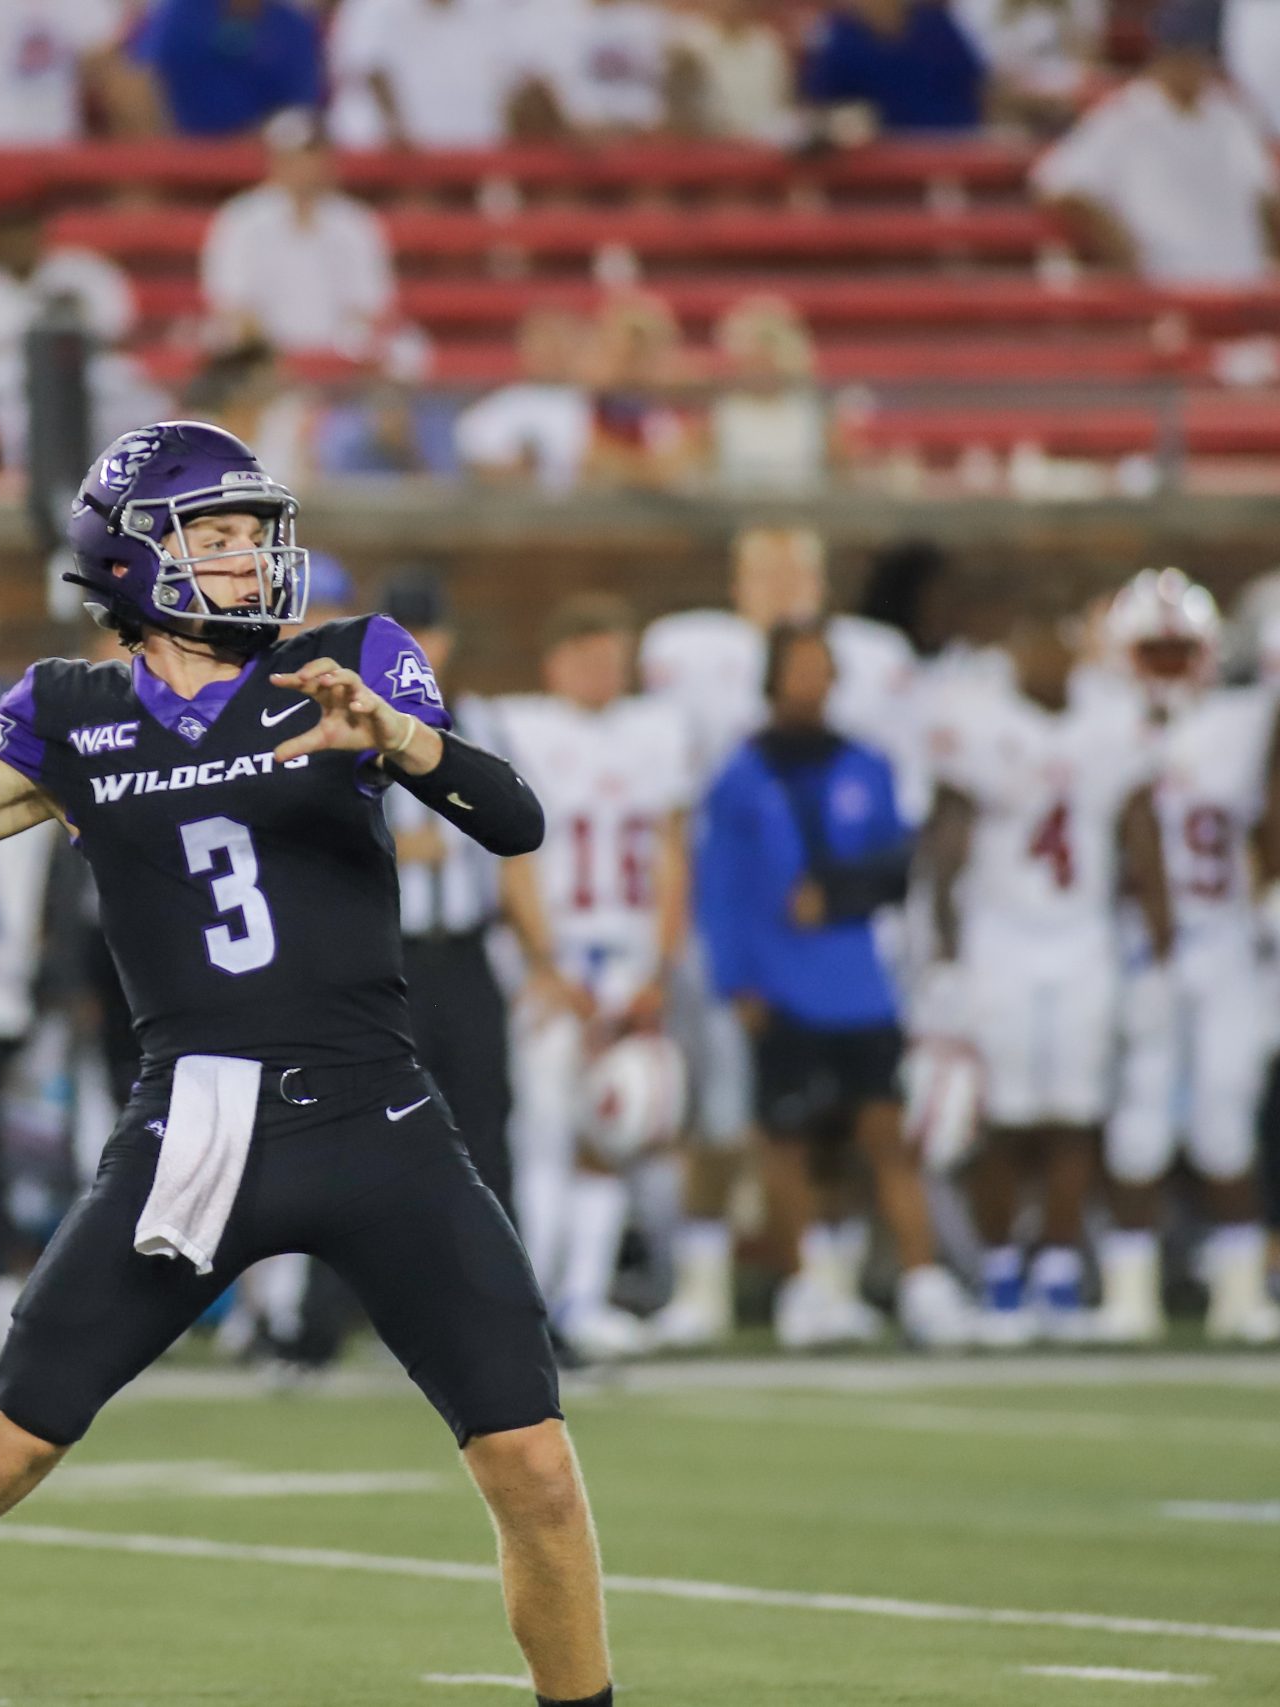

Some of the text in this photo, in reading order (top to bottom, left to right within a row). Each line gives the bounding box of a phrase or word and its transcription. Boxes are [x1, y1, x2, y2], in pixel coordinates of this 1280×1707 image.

[70, 721, 139, 755] WAC
[1028, 798, 1074, 889] 4
[178, 815, 276, 974] 3
